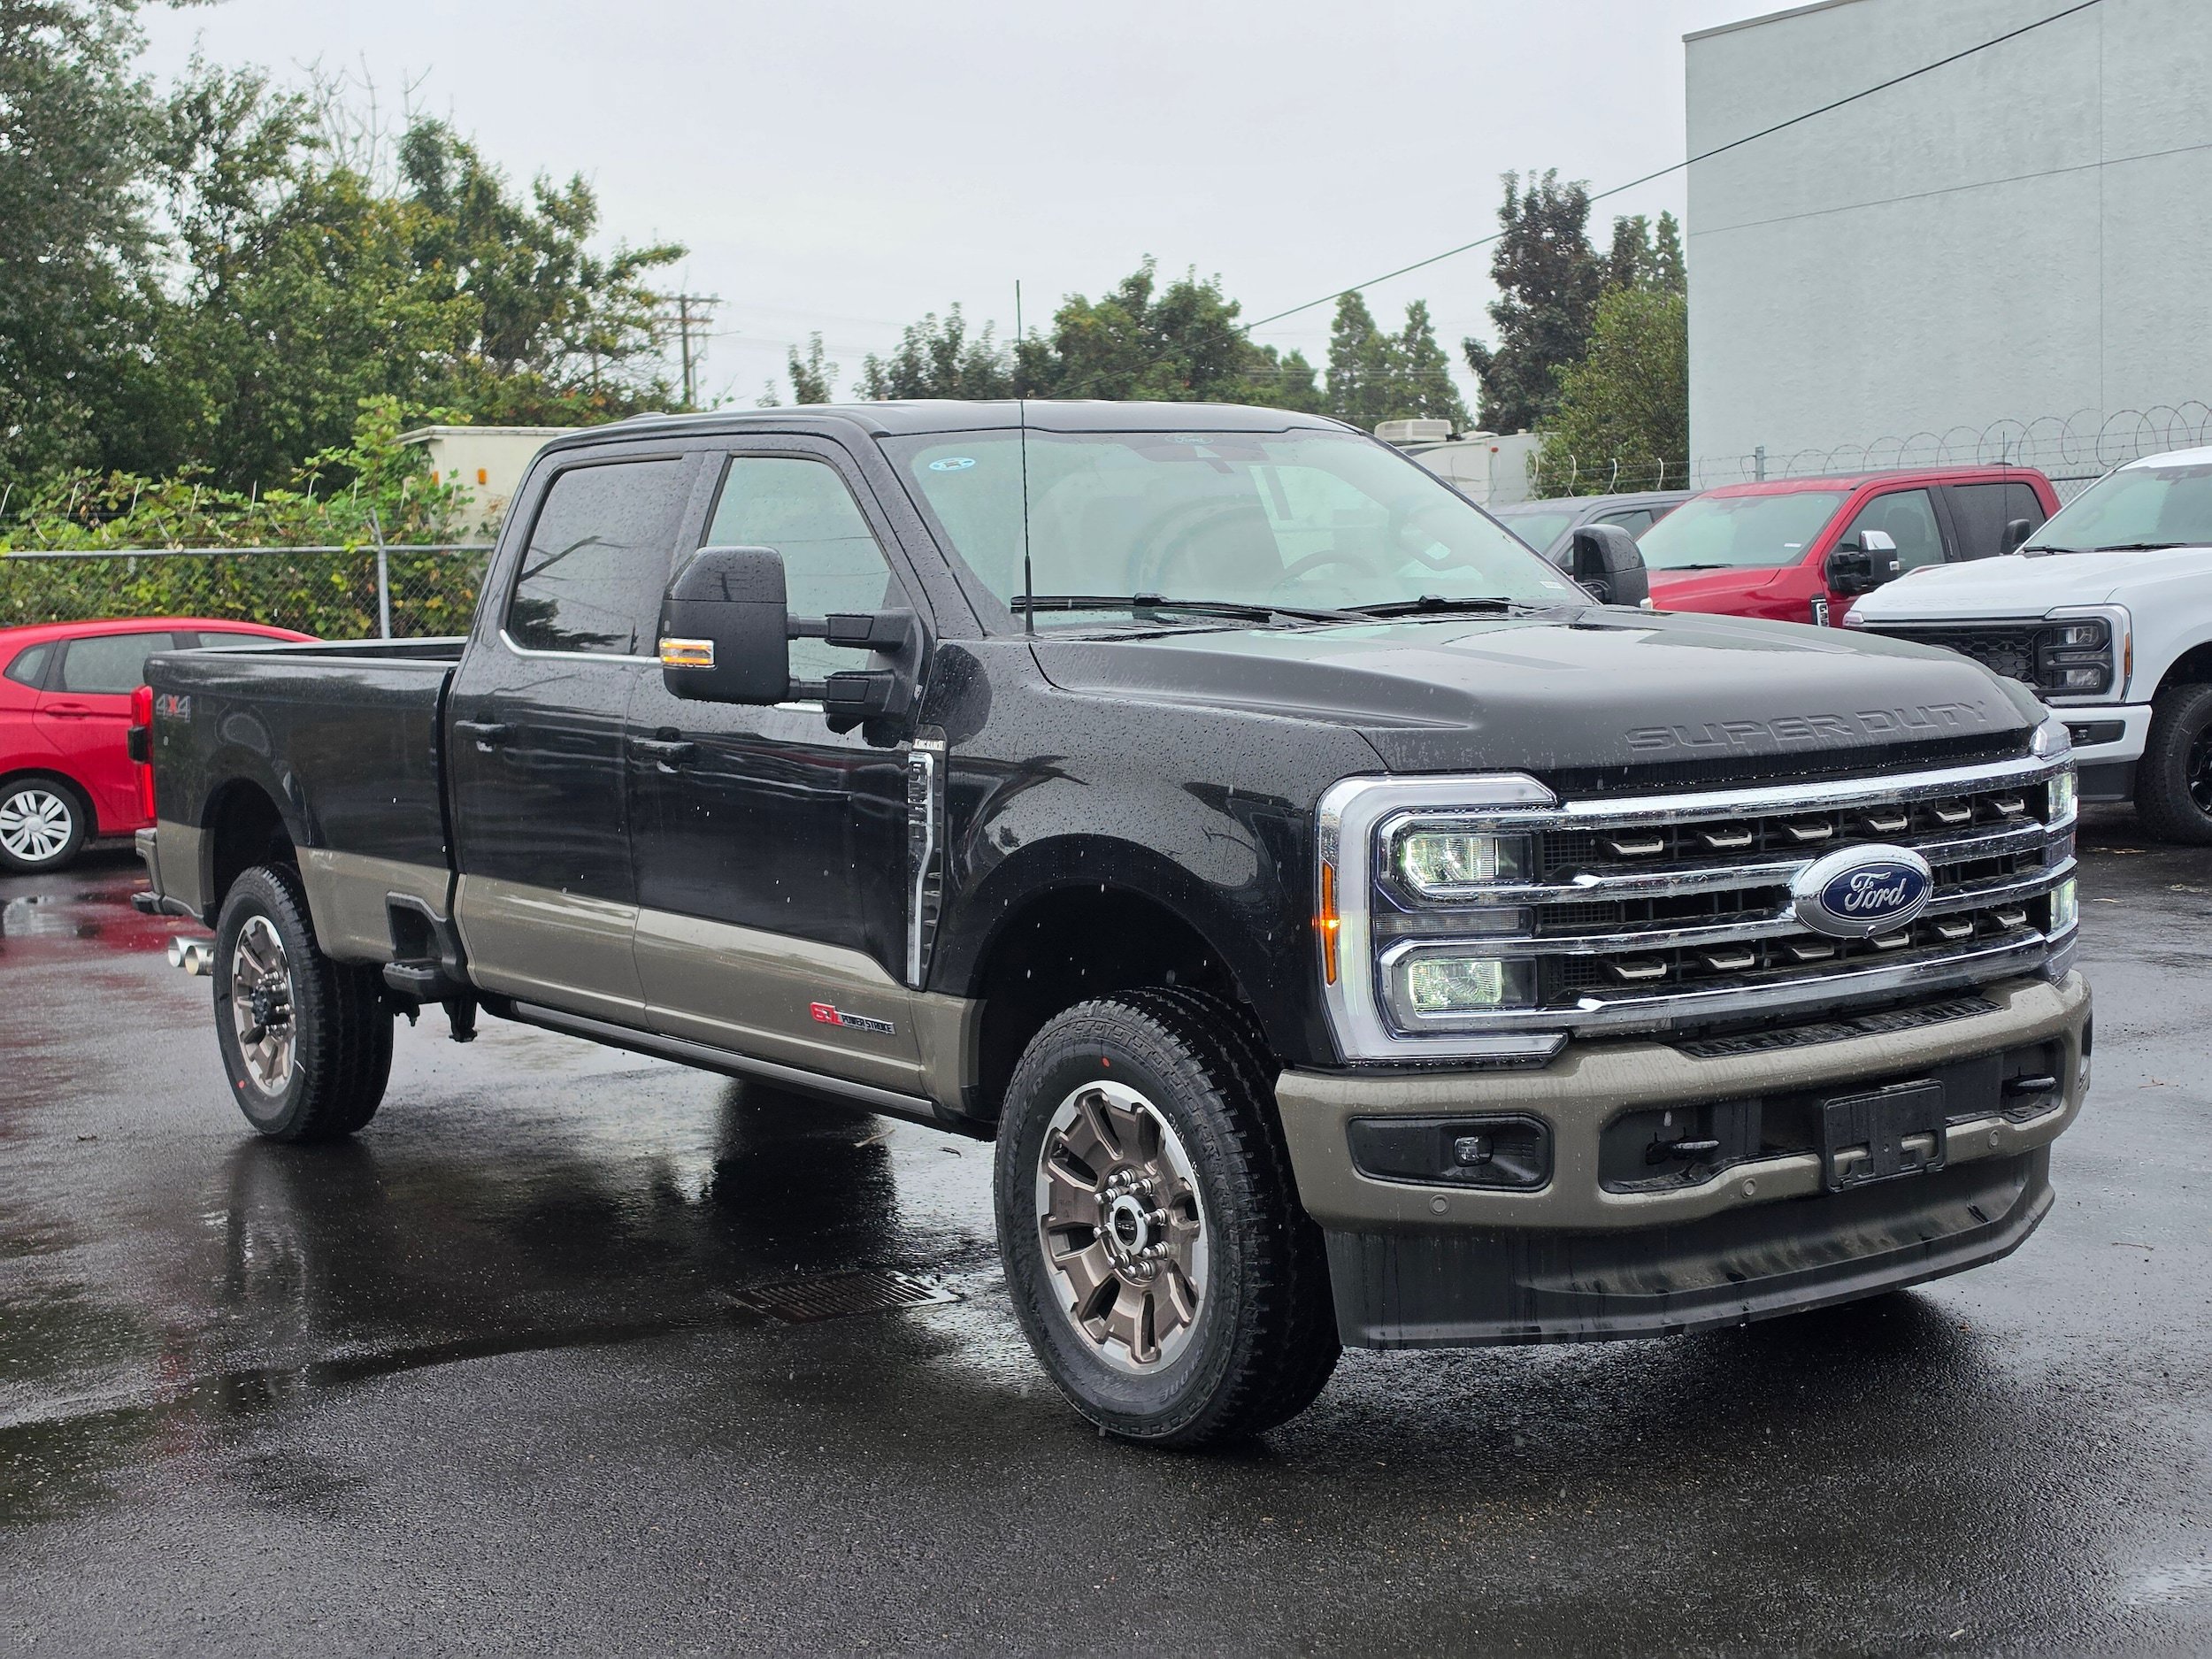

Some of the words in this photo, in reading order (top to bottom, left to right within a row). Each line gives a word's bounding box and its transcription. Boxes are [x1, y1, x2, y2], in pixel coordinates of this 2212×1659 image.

[1624, 713, 1855, 751] SUPER
[1856, 700, 1987, 733] DUTY
[1844, 872, 1907, 912] Ford
